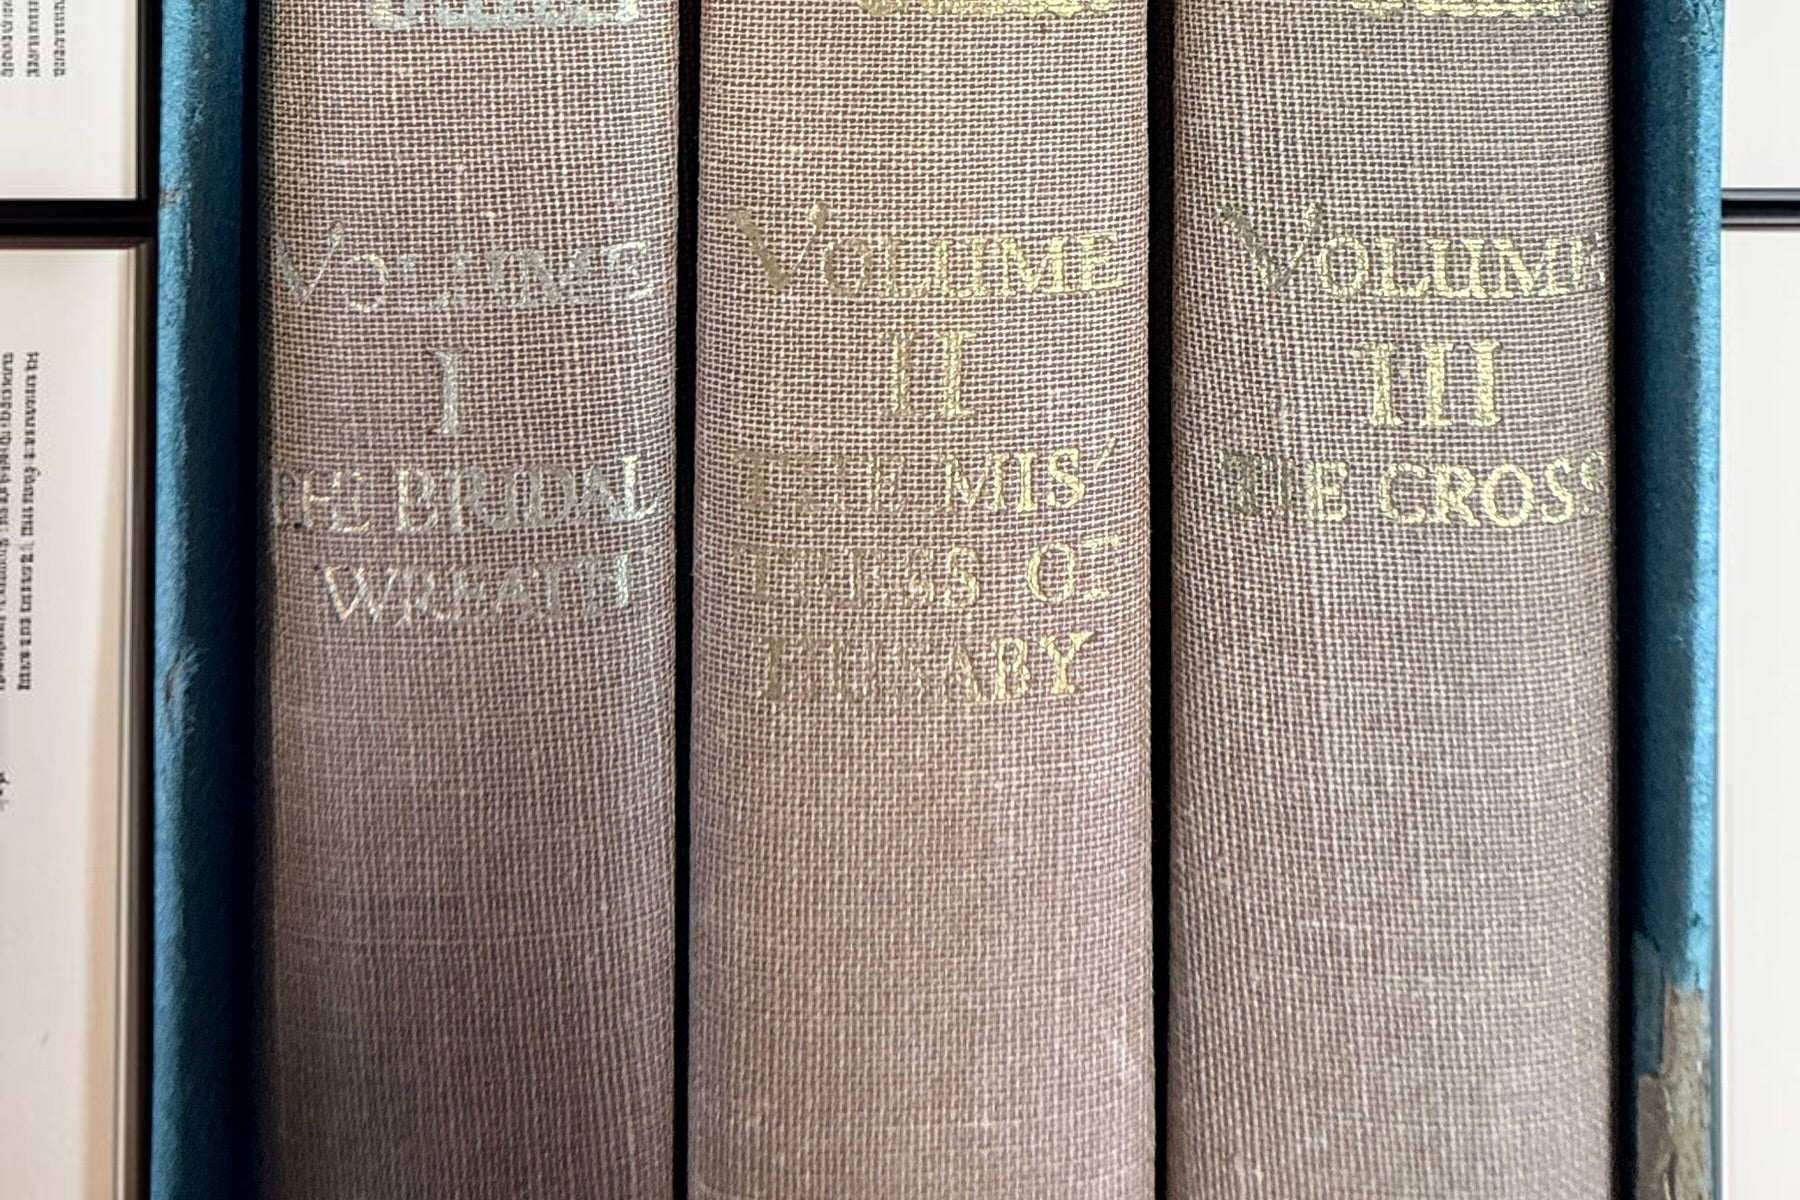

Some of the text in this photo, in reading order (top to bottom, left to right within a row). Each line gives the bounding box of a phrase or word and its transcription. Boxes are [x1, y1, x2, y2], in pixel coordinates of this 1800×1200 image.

[728, 202, 1125, 298] VOLUME
[433, 347, 470, 436] I
[879, 330, 978, 418] II
[1352, 337, 1502, 428] III
[394, 454, 657, 534] BRIDAL
[1377, 451, 1607, 527] CROSS
[320, 551, 634, 624] WREATH
